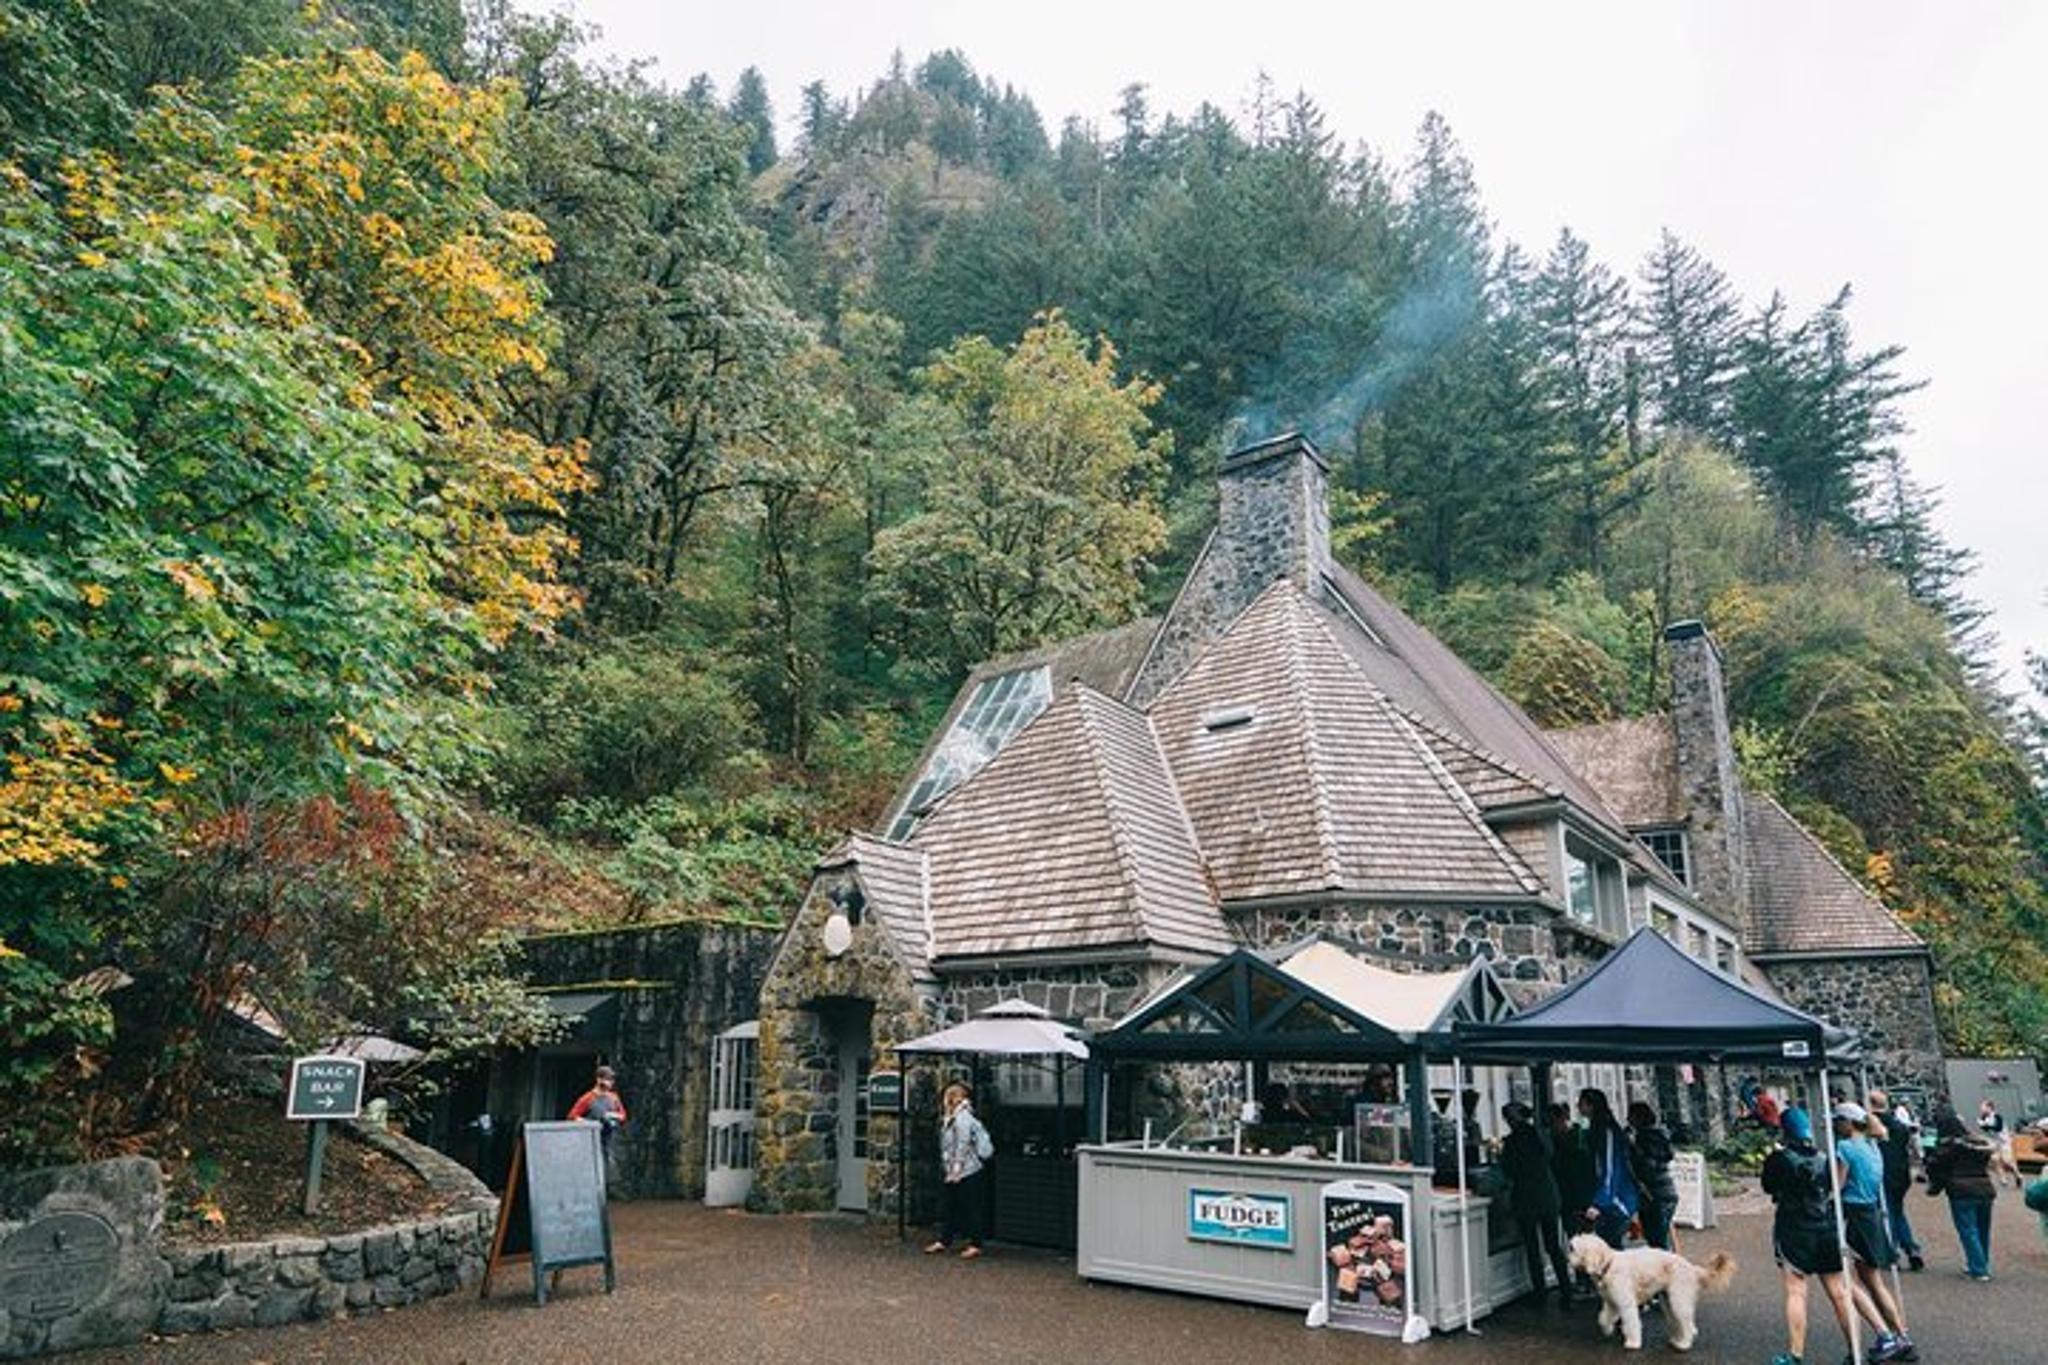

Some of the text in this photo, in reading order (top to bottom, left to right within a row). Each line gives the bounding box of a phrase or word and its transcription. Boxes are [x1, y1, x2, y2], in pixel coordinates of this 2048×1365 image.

[302, 1066, 356, 1078] SNACK
[310, 1081, 346, 1094] BAR
[1201, 1204, 1280, 1226] FUDGE
